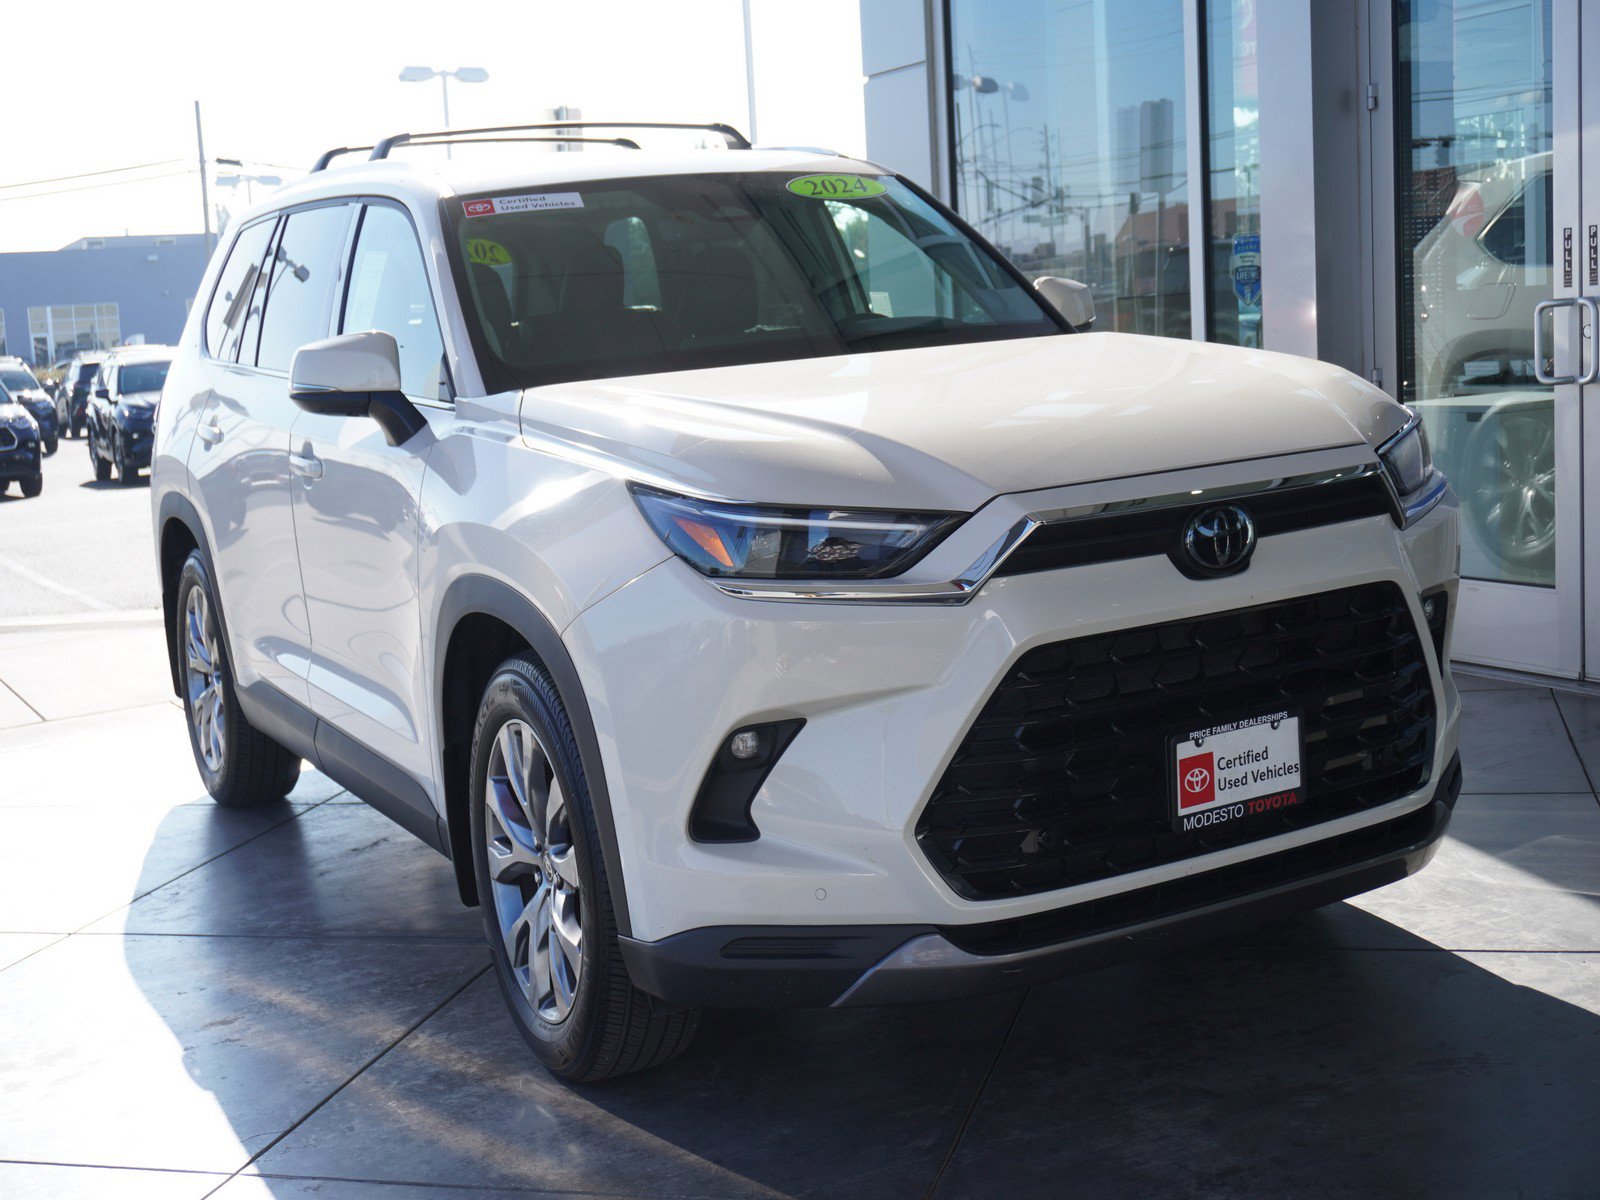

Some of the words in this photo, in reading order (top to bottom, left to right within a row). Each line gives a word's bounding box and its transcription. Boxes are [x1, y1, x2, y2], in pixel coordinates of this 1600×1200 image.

[804, 178, 868, 196] 2024
[499, 195, 546, 205] Certified
[500, 203, 528, 212] Used
[530, 200, 576, 209] Vehicles
[1189, 728, 1211, 741] PRICE
[1212, 721, 1239, 735] FAMILY
[1239, 711, 1288, 729] DEALERSHIPS
[1217, 746, 1269, 771] Certified
[1218, 772, 1248, 791] Used
[1251, 762, 1300, 783] Vehicles
[1183, 804, 1244, 831] MODESTO
[1248, 792, 1297, 814] TOYOTA
